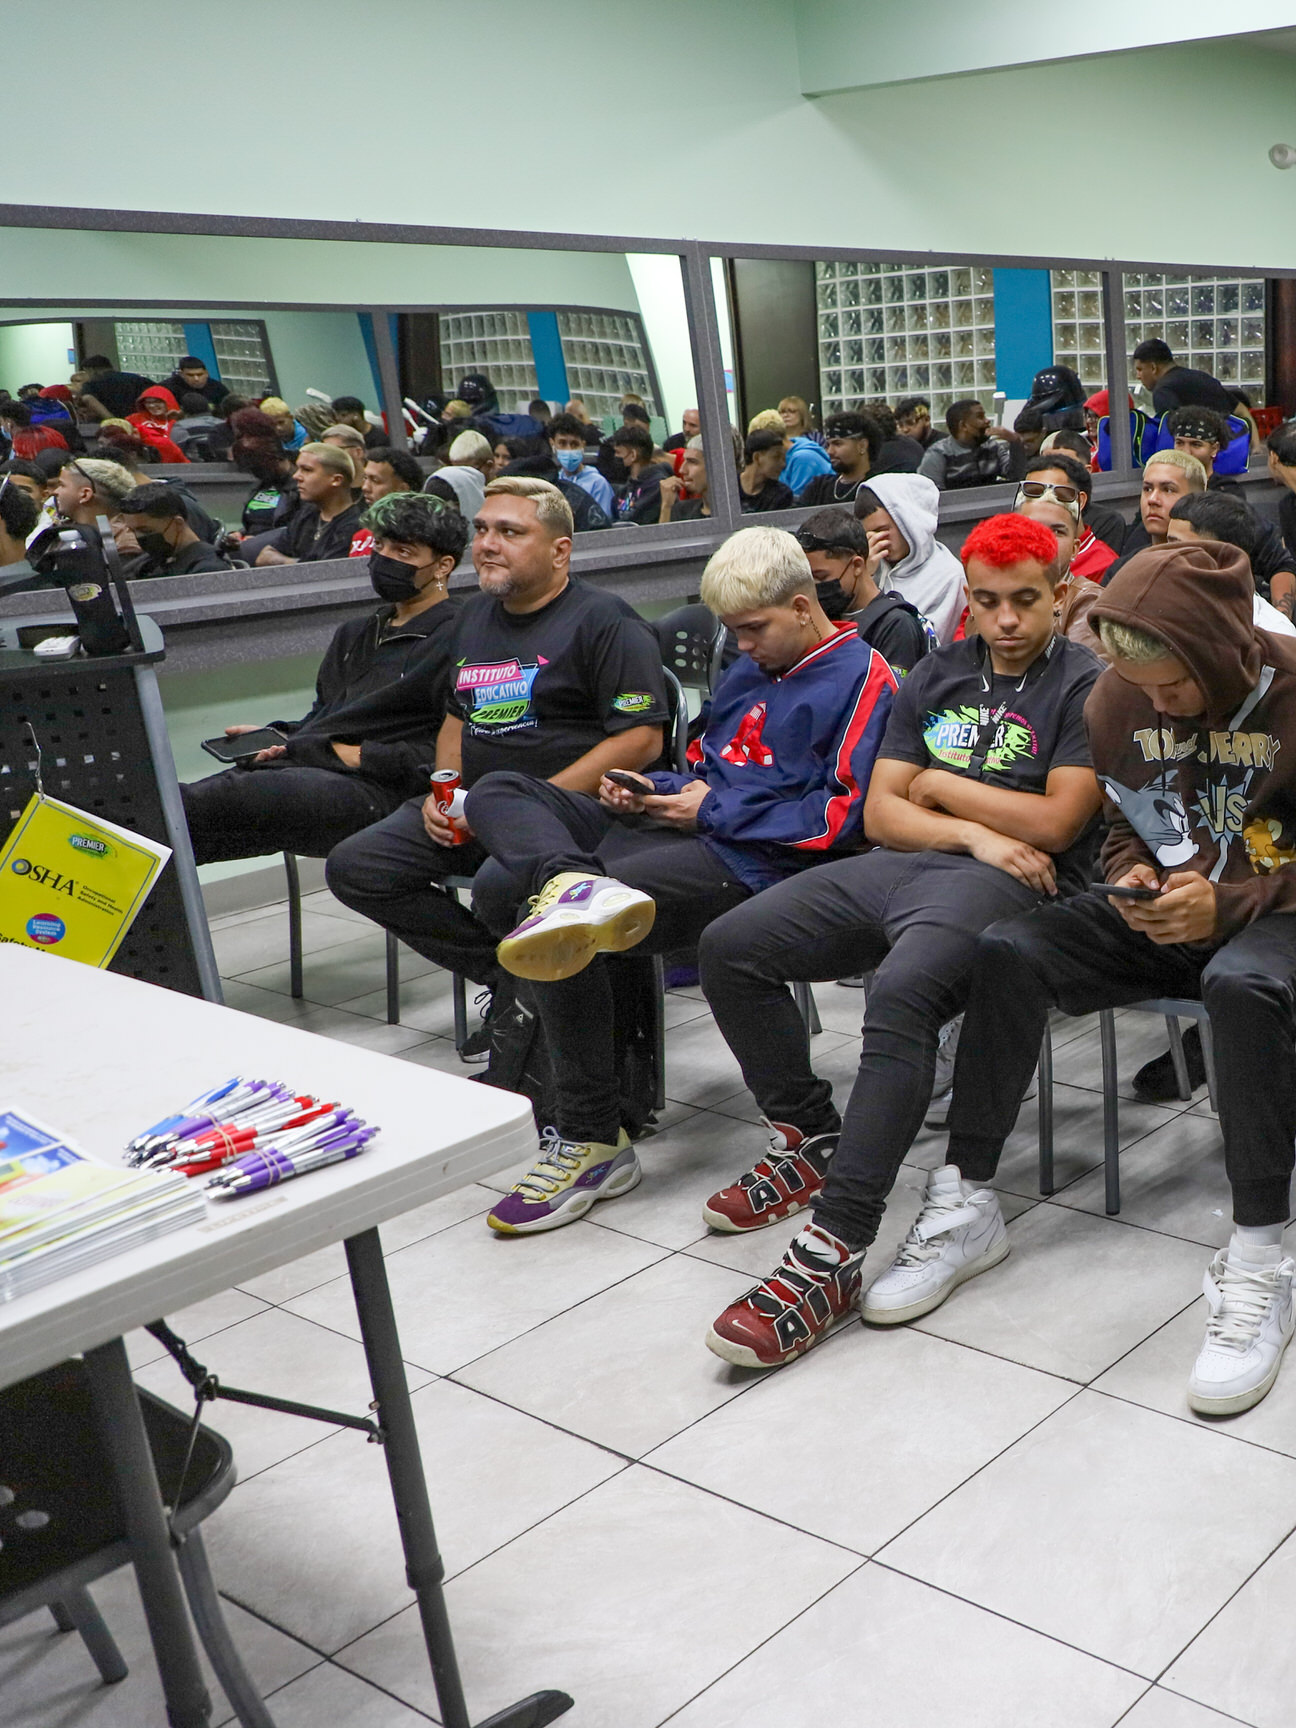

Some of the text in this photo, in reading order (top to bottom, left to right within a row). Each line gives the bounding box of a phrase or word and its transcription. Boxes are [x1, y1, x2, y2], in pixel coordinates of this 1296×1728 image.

[459, 665, 517, 685] INSTITUTO
[475, 681, 529, 703] EDUCATIVO
[617, 695, 643, 708] PREMIER
[477, 705, 525, 720] PREMIER
[979, 703, 990, 727] NIKE
[991, 701, 1008, 725] NIKE
[936, 723, 1005, 749] PREMR
[937, 749, 972, 763] Instituto
[1197, 730, 1281, 772] JERRY
[1199, 785, 1248, 833] VS
[71, 836, 106, 852] PREMIER
[11, 858, 75, 897] OSHA
